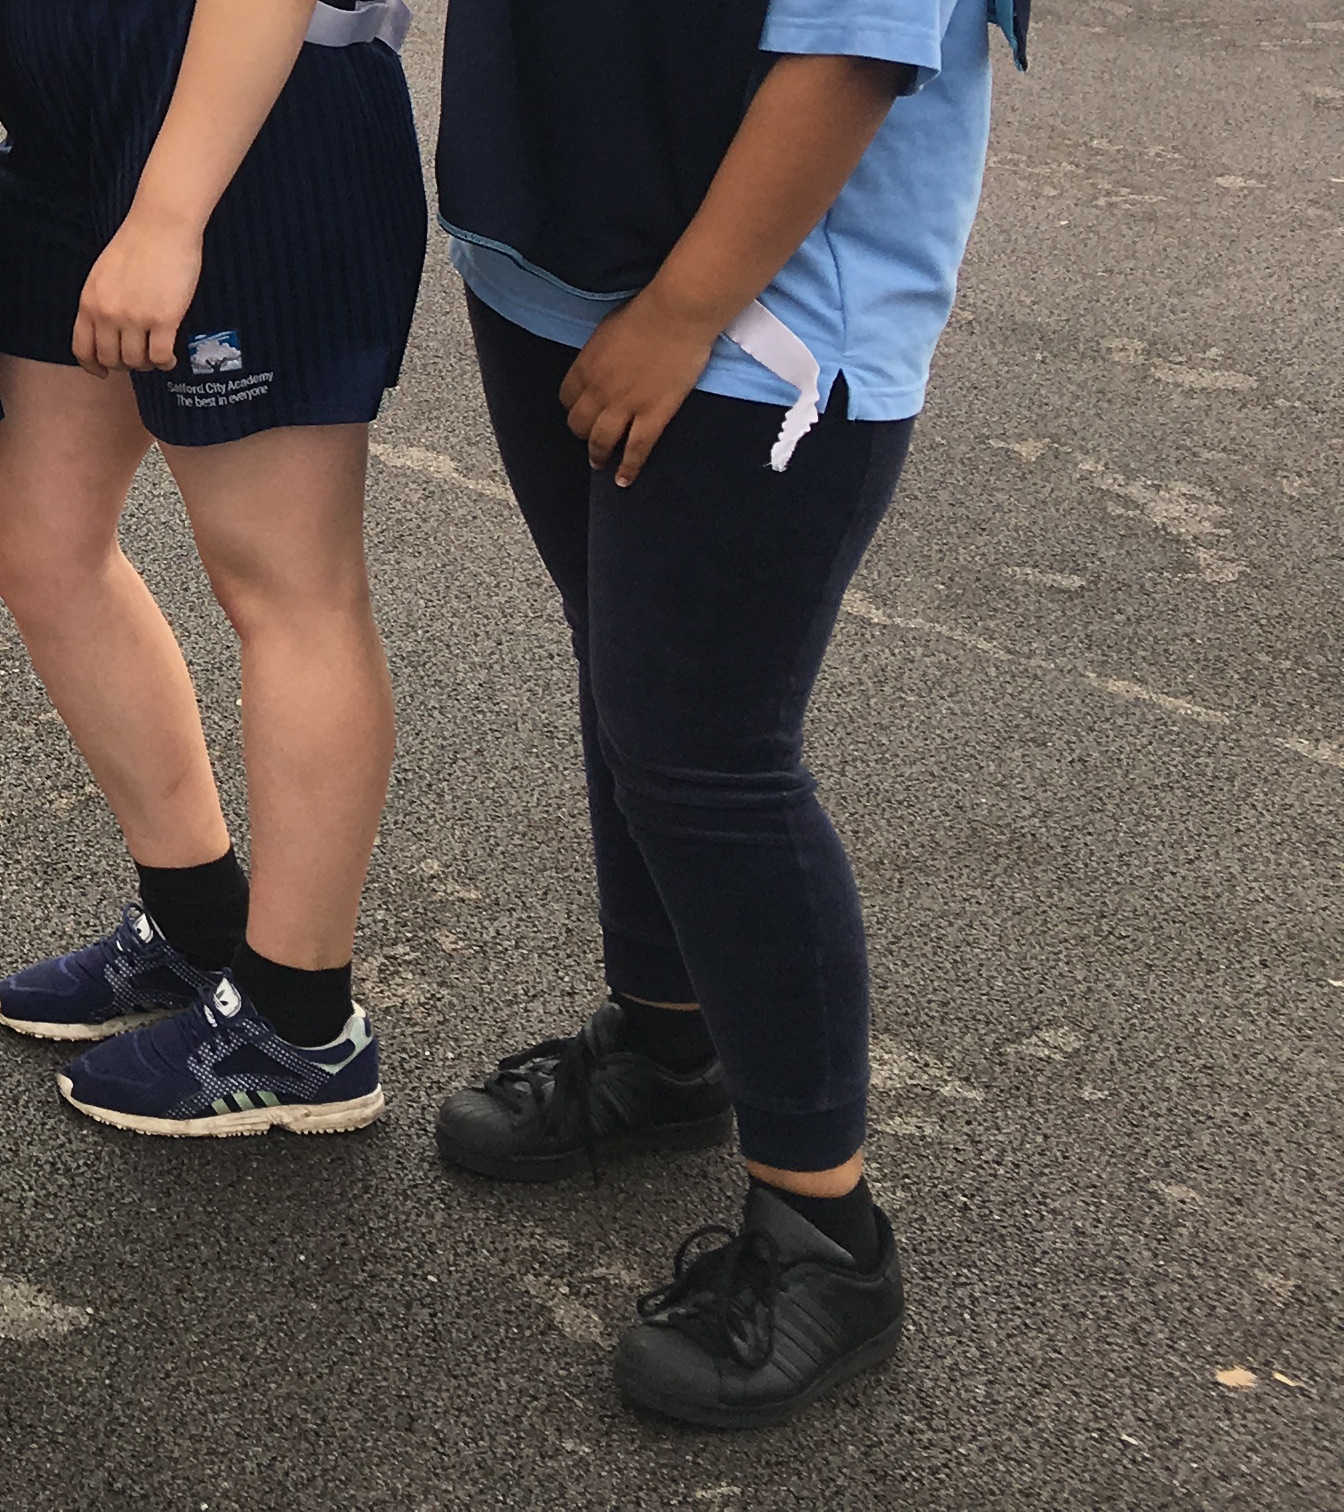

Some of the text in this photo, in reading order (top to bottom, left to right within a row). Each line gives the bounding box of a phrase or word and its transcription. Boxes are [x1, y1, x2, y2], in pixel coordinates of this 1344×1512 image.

[167, 371, 274, 395] Salford City Academy
[176, 385, 269, 407] The best in everyone
